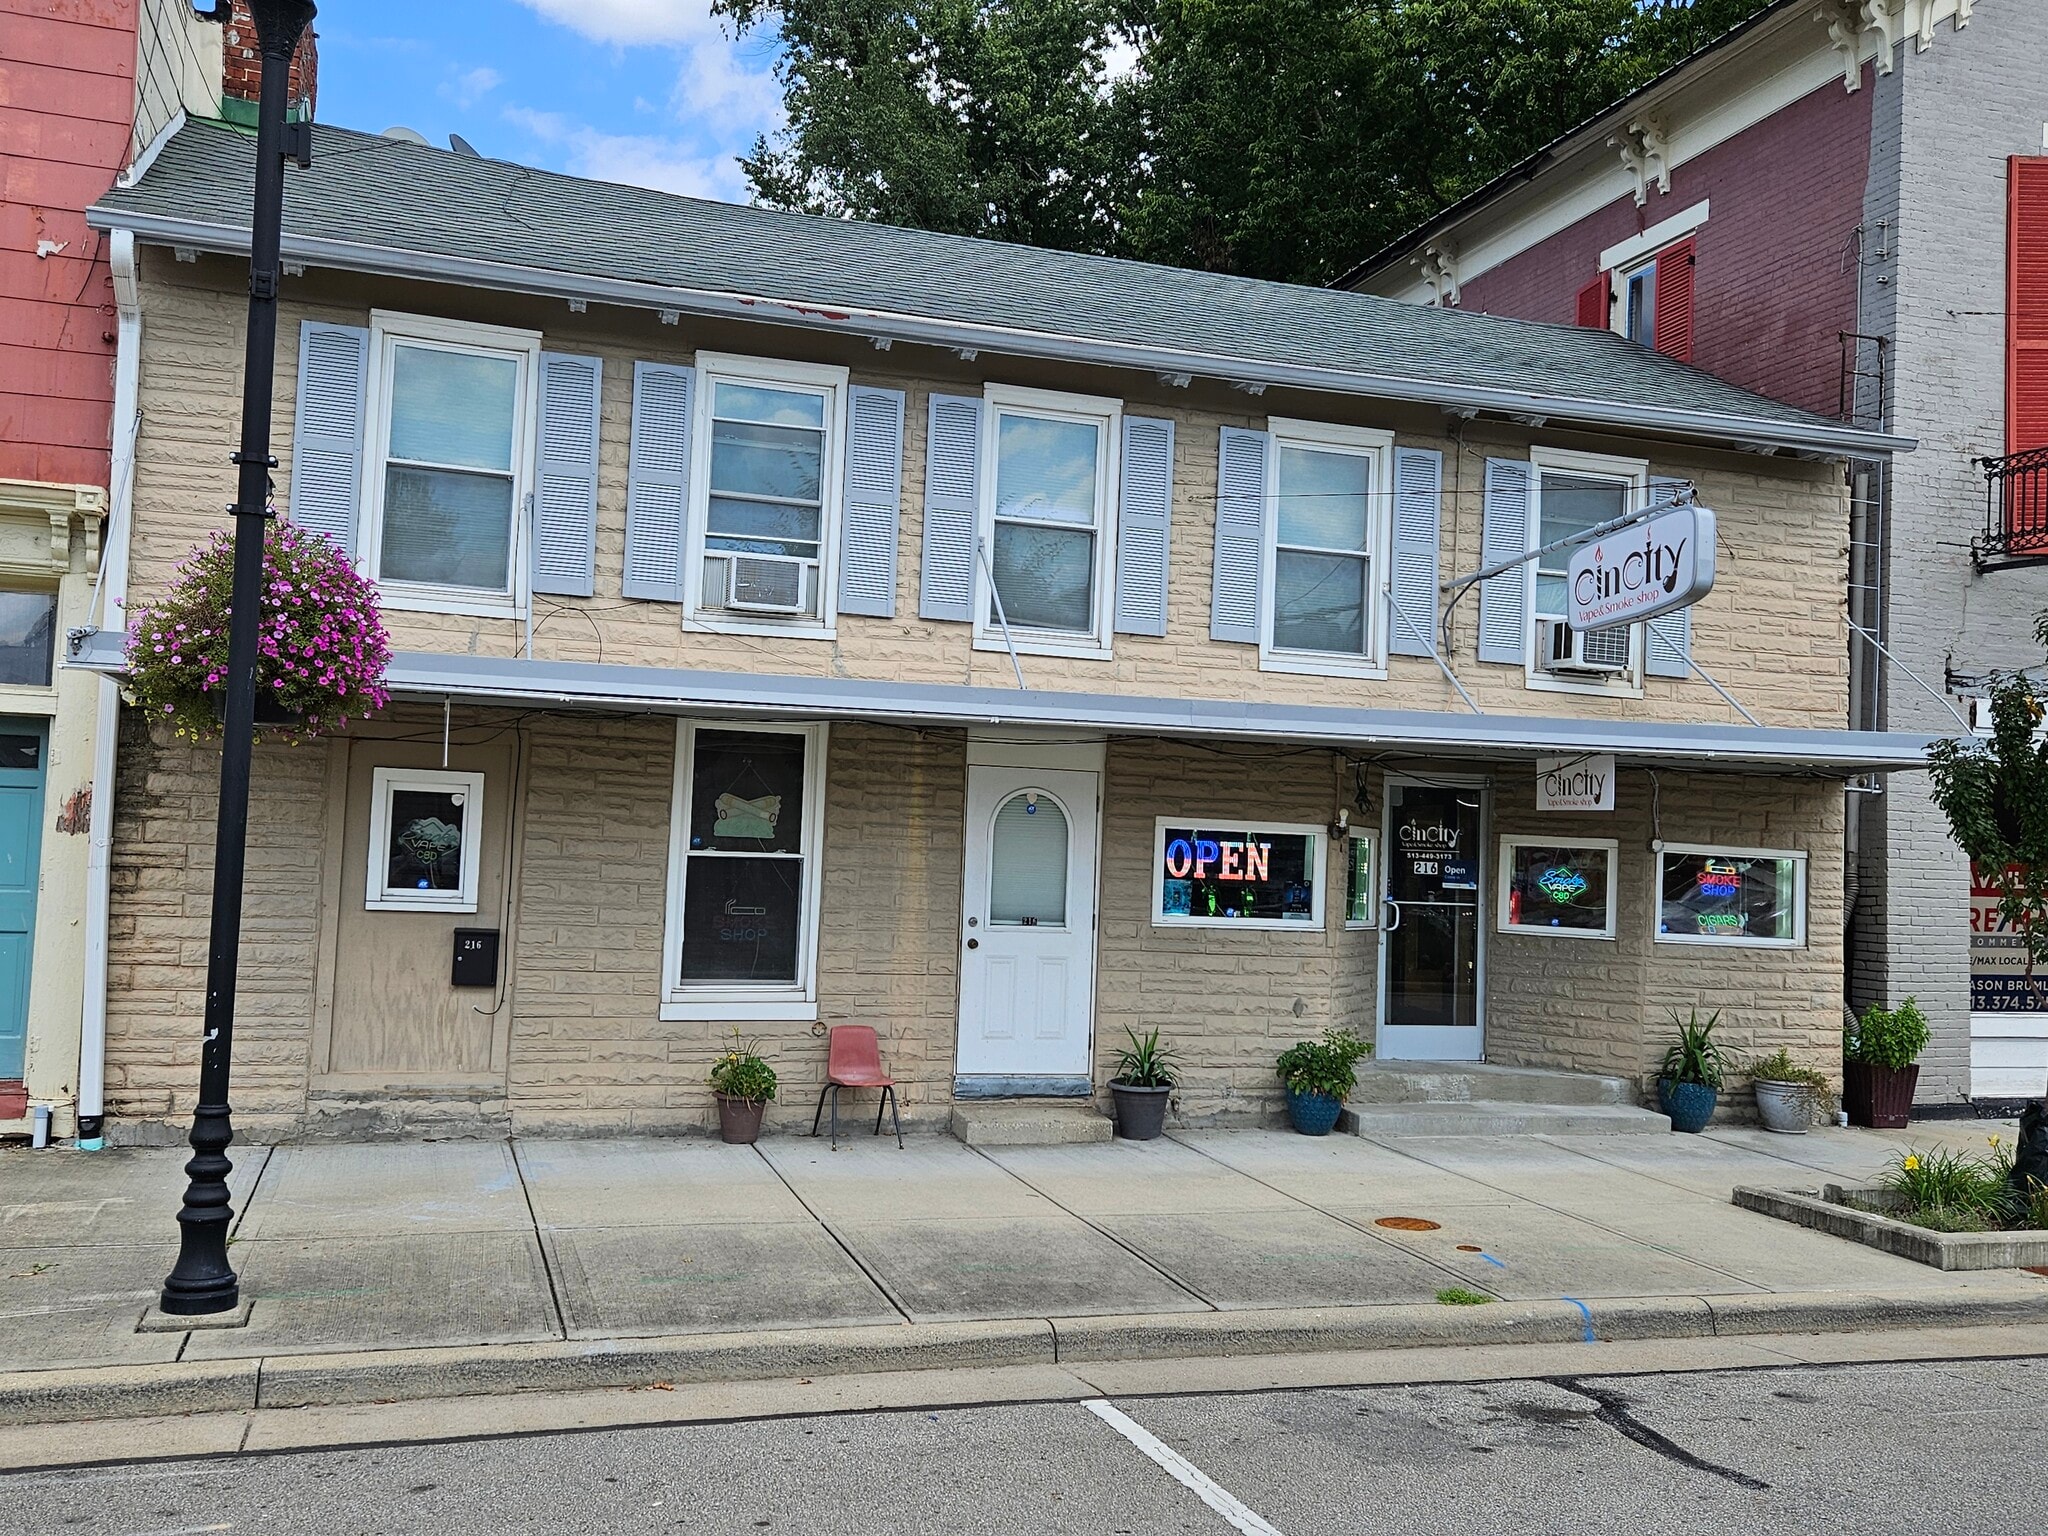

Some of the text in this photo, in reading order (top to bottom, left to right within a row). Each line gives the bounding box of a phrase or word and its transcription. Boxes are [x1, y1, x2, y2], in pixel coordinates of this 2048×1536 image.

[1575, 527, 1687, 606] CinCity
[1636, 589, 1660, 606] shop
[411, 838, 447, 852] VAPE
[416, 850, 438, 861] CBD
[1166, 838, 1272, 882] OPEN
[1415, 863, 1437, 874] 216
[1444, 865, 1466, 875] Open
[1539, 870, 1586, 887] Smoke
[1697, 873, 1742, 887] SMOKE
[1547, 883, 1576, 893] VAPE
[1701, 884, 1736, 896] SHOP
[1552, 891, 1570, 900] CBD
[1697, 915, 1738, 926] CIGARS
[720, 928, 767, 941] SHOP
[464, 940, 482, 950] 216
[1999, 957, 2028, 966] LOCAL
